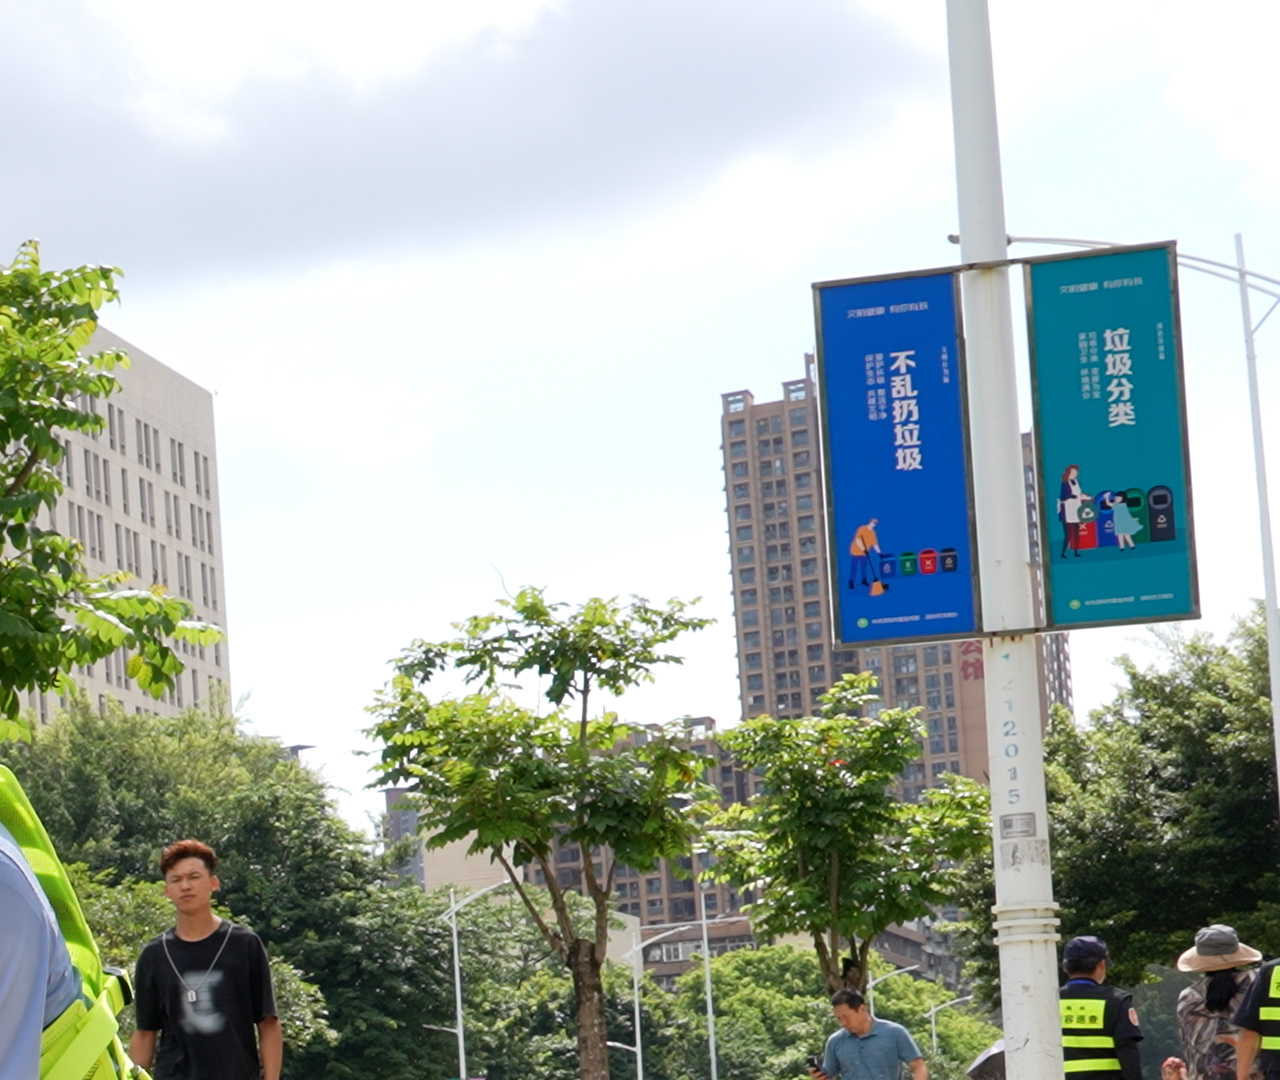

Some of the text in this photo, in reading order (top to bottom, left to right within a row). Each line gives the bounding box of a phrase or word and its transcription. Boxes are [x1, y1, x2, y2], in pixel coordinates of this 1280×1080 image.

[889, 350, 923, 471] 不乱扔垃圾
[1103, 328, 1136, 427] 垃圾分类
[1061, 1014, 1099, 1025] 容巡查
